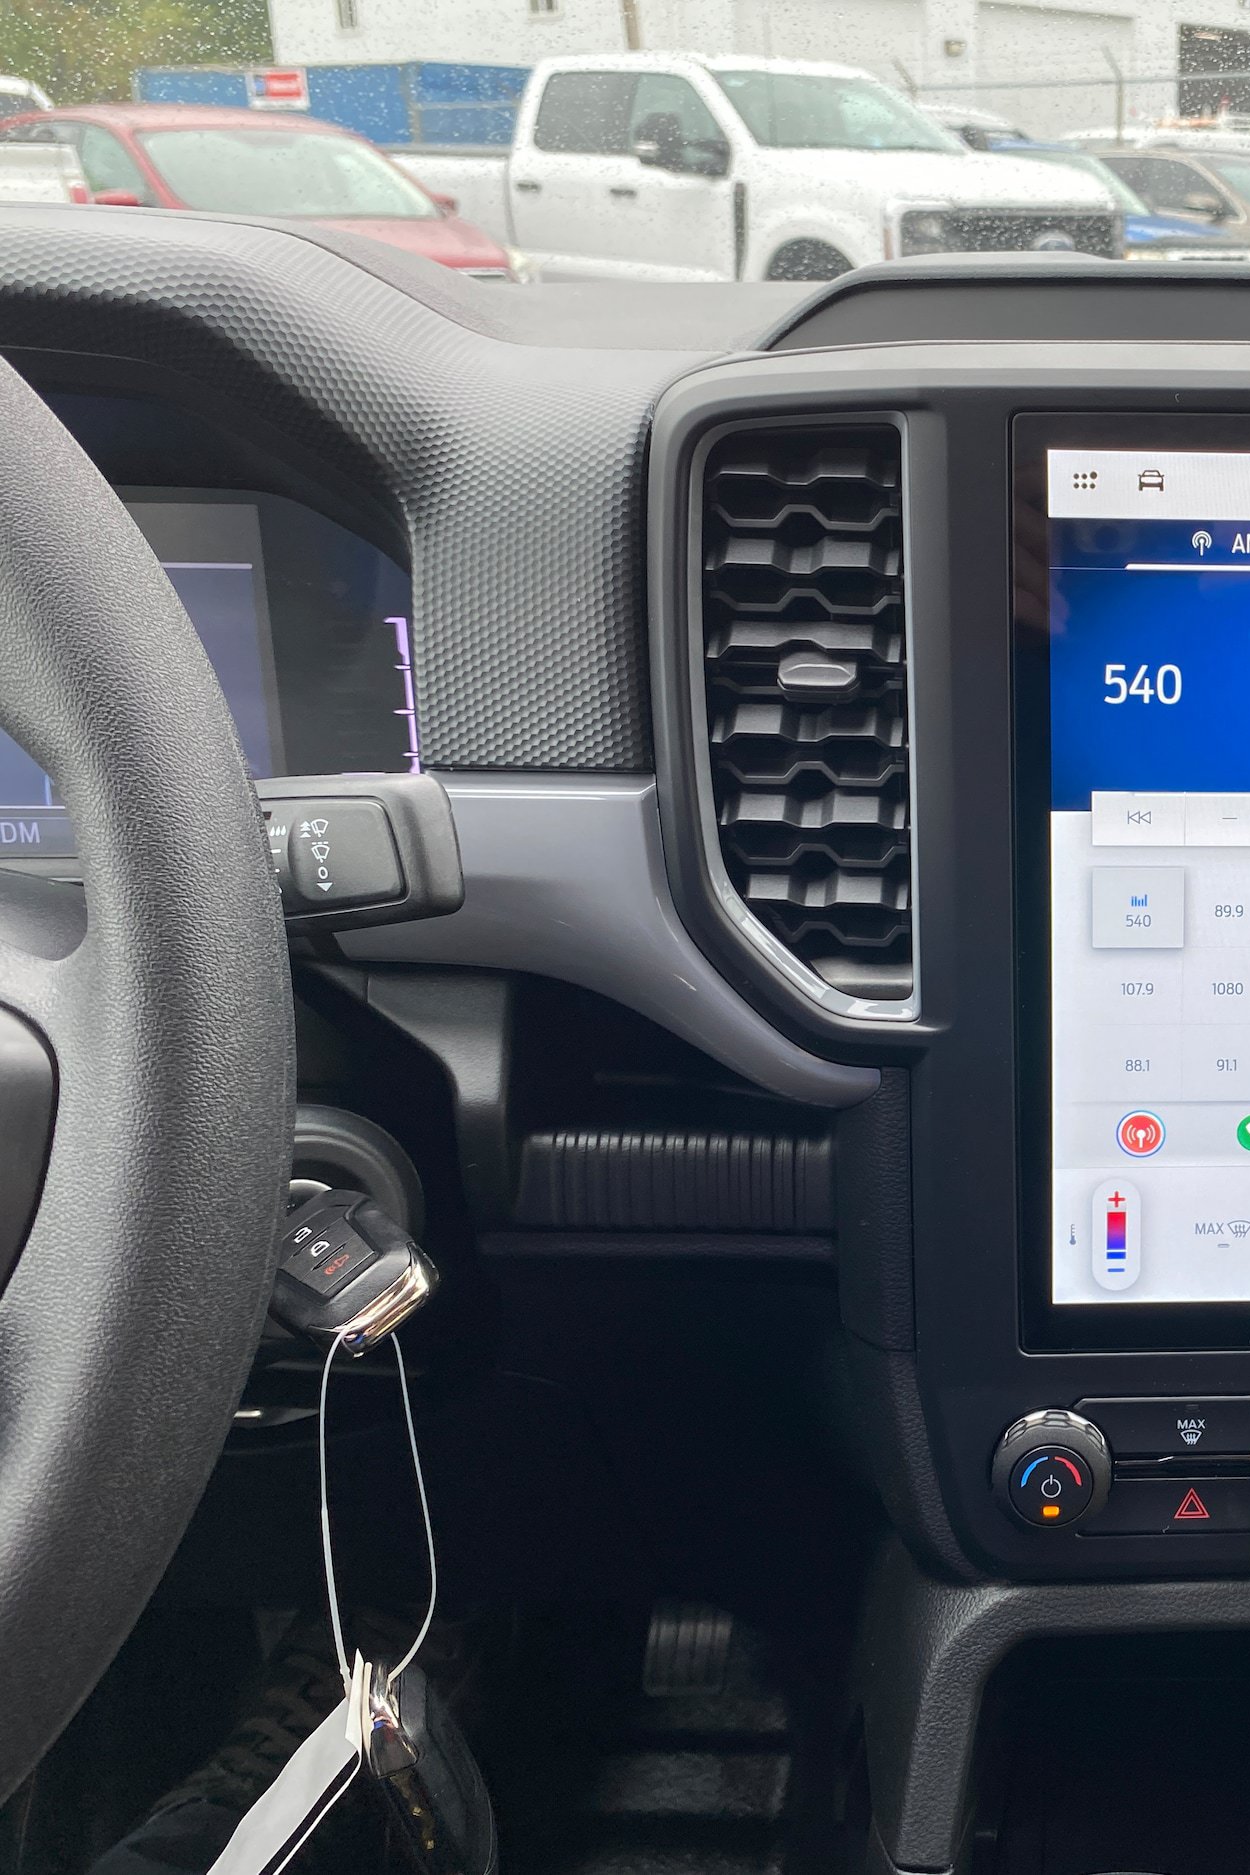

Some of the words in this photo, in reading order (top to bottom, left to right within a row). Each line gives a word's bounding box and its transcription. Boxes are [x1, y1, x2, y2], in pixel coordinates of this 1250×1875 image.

[1103, 664, 1182, 705] 540
[1214, 904, 1244, 918] 89.9
[1125, 914, 1152, 928] 540
[1121, 982, 1154, 996] 107.9
[1211, 982, 1244, 996] 1080
[1125, 1059, 1151, 1073] 88.1
[1216, 1058, 1238, 1072] 91.1
[1194, 1222, 1225, 1236] MAX
[1177, 1419, 1206, 1430] MAX
